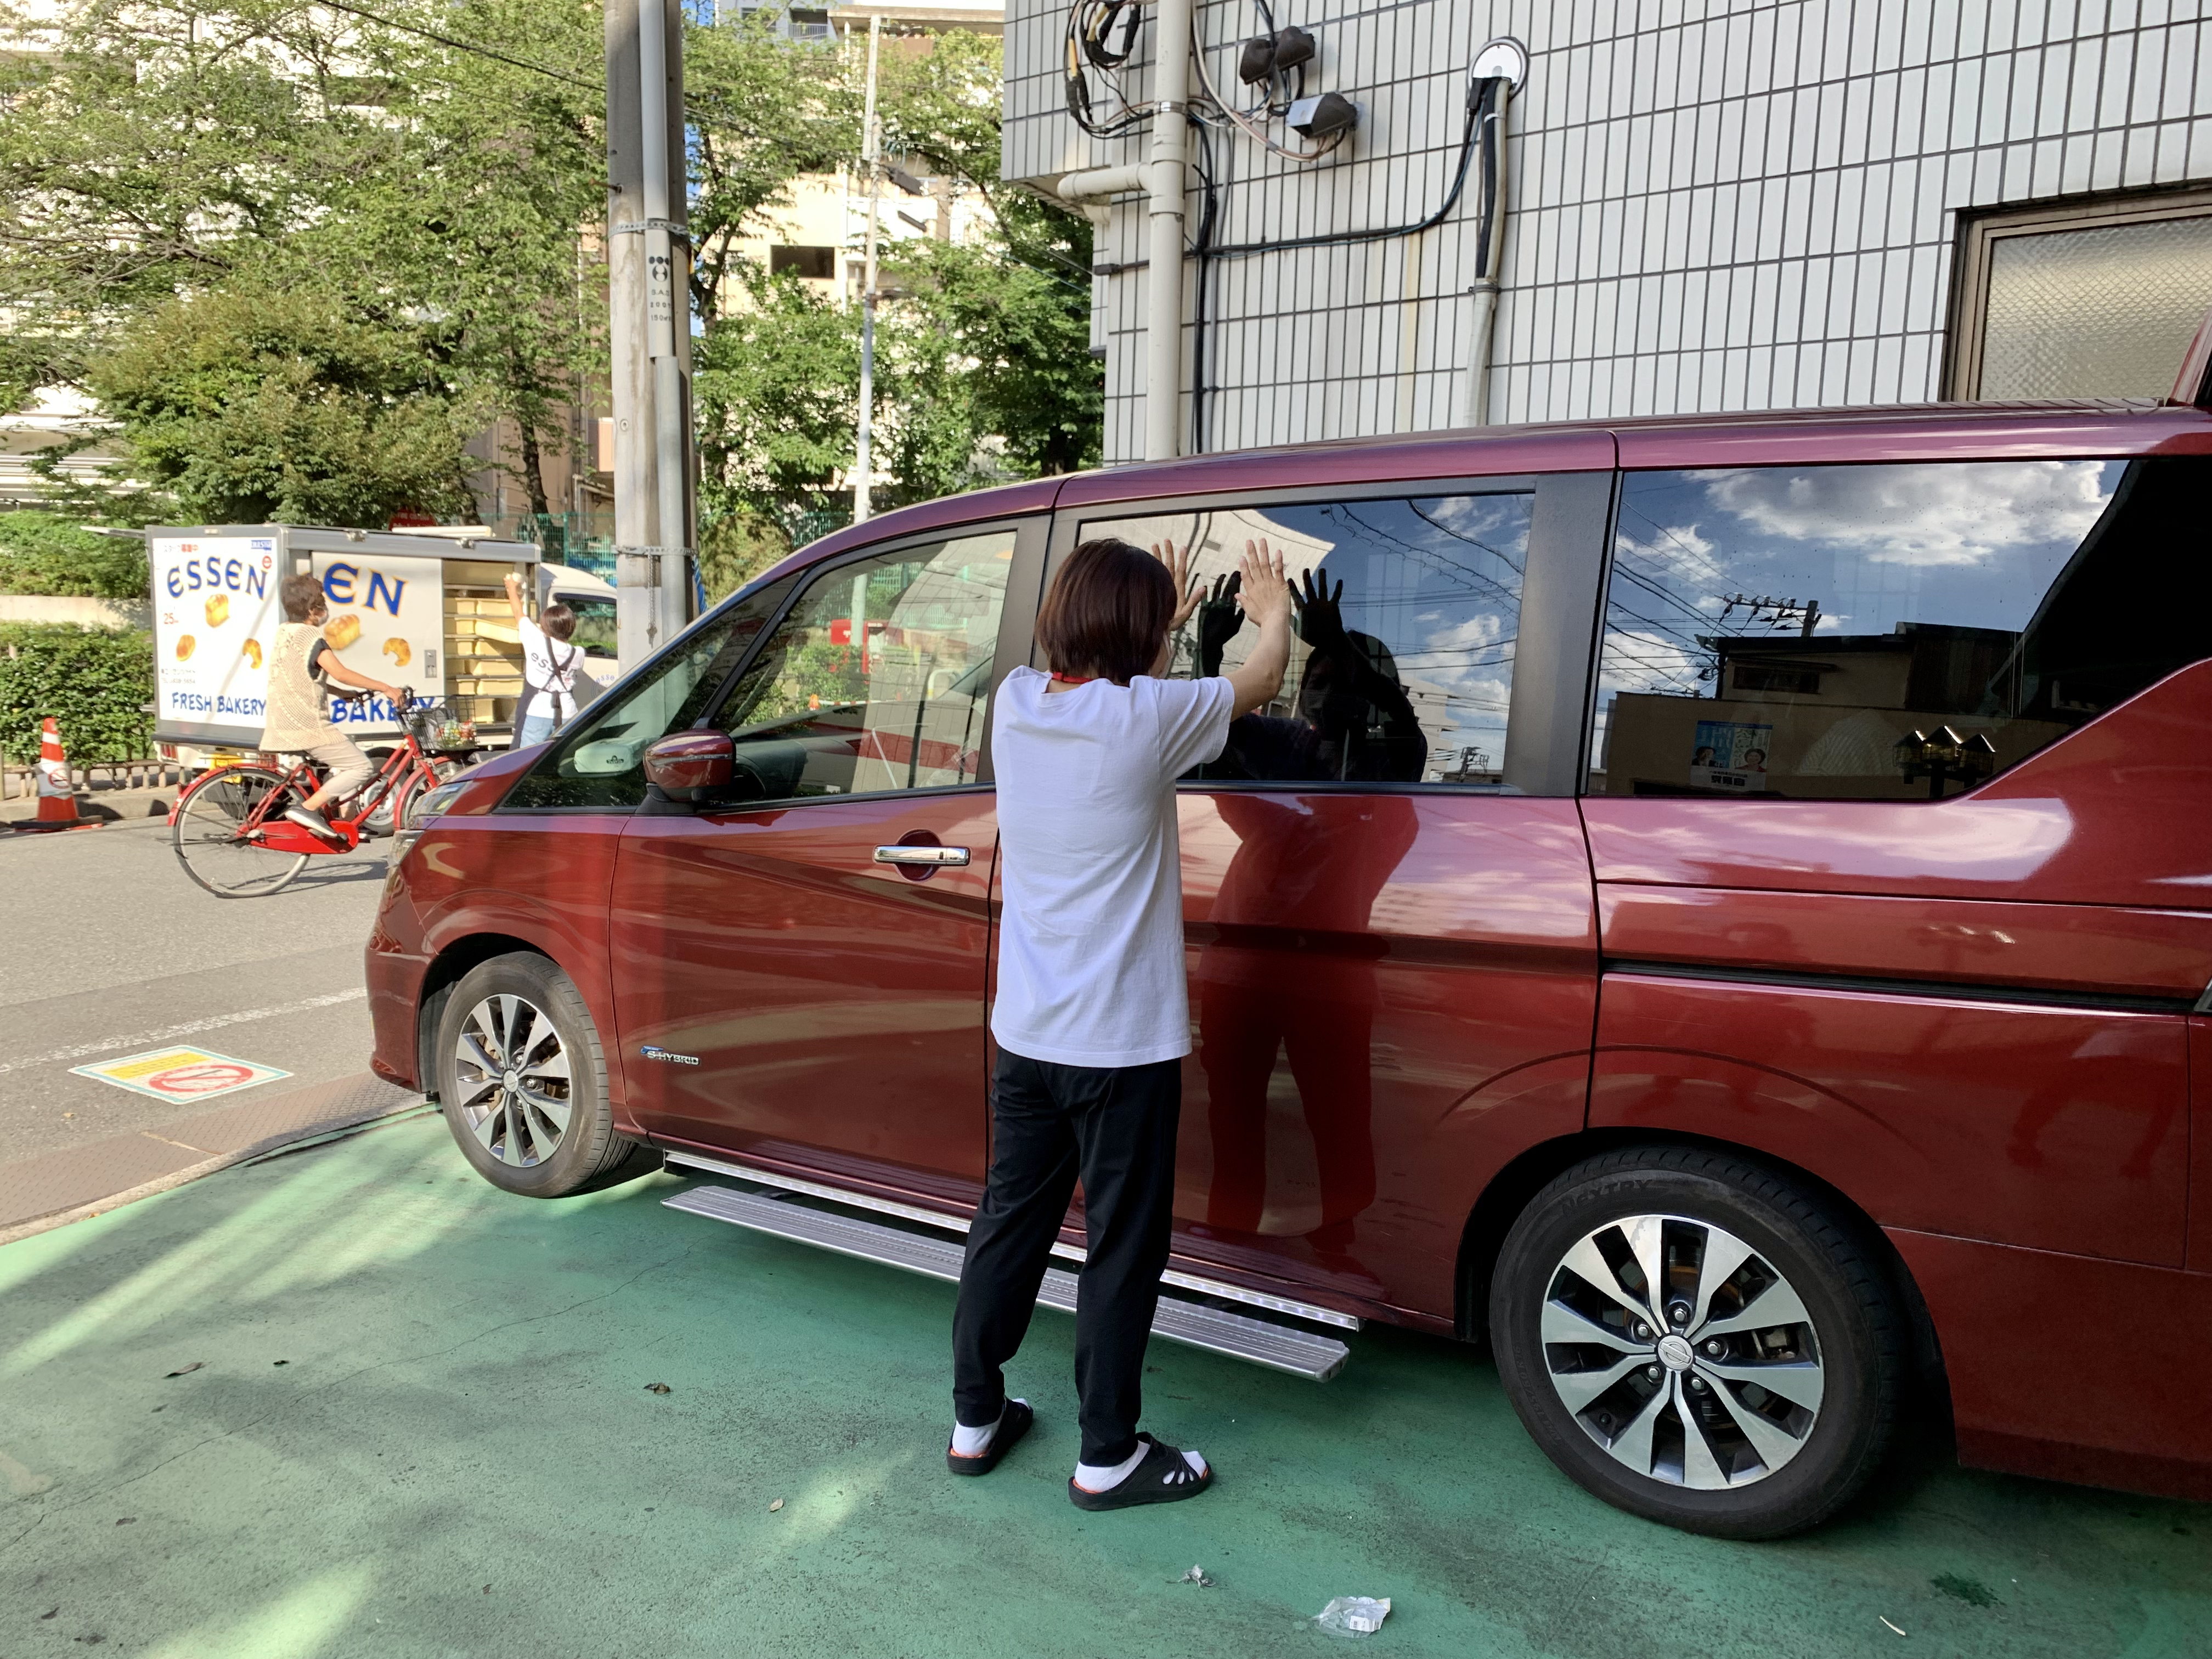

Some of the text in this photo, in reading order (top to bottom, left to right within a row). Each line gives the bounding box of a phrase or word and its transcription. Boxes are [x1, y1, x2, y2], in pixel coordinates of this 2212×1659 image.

[262, 555, 272, 569] e
[167, 556, 268, 601] ESSEN
[595, 674, 618, 684] esse
[172, 692, 267, 716] FRESH BAKERY
[331, 697, 435, 724] BAKEY
[647, 1050, 699, 1065] S-HYBRID
